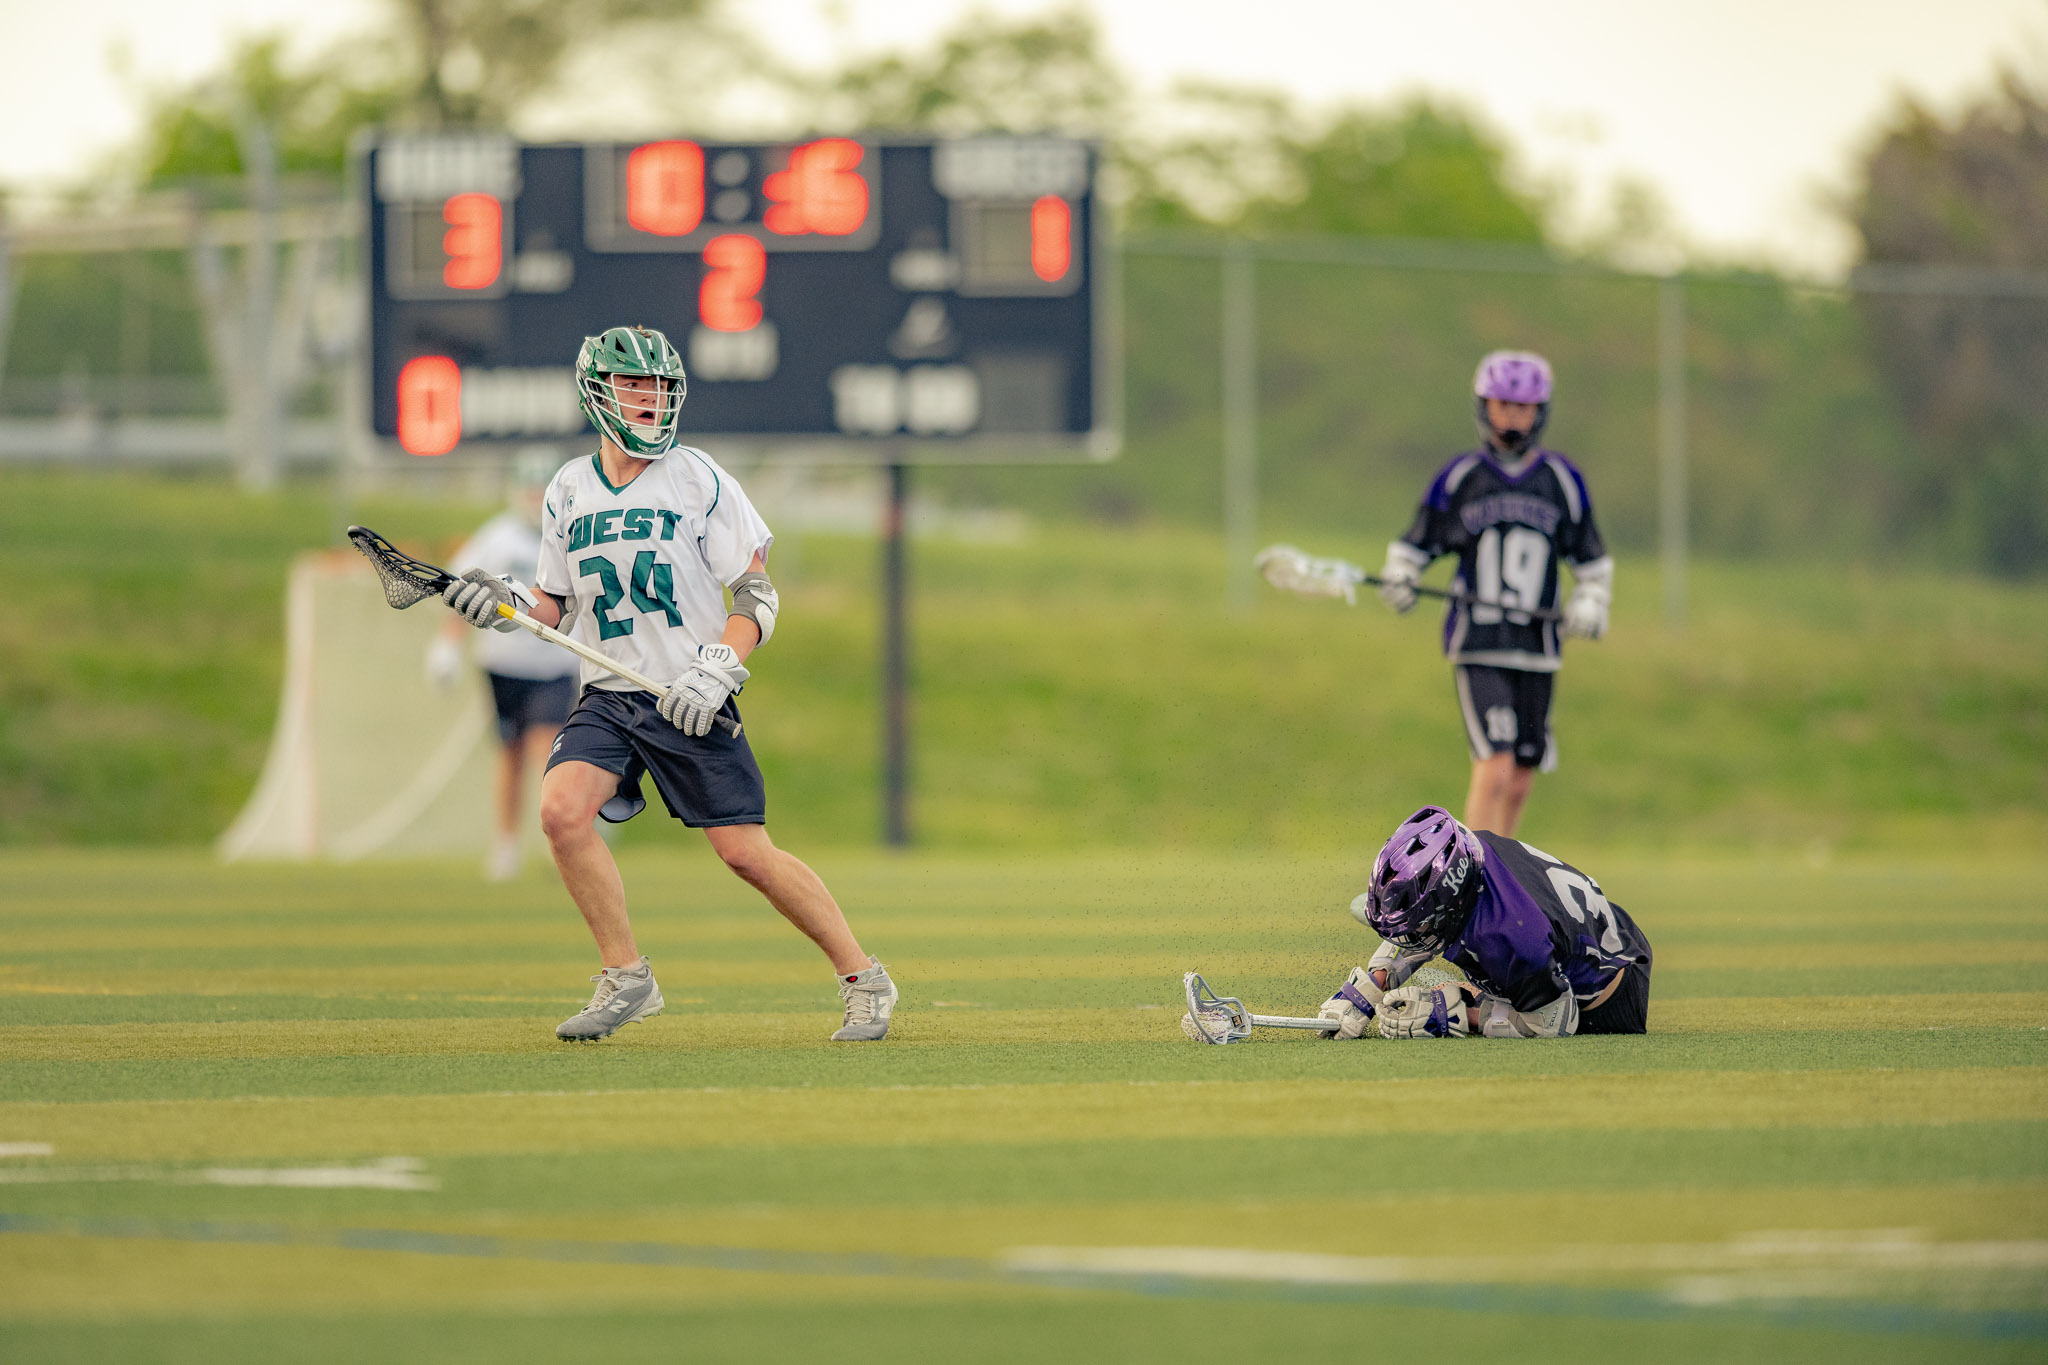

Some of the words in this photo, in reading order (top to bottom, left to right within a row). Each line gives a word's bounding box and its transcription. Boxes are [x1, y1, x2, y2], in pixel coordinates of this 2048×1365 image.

[443, 193, 501, 289] 3
[700, 234, 766, 332] 2
[567, 508, 683, 552] WEST
[1471, 526, 1550, 626] 19
[579, 550, 684, 642] 24
